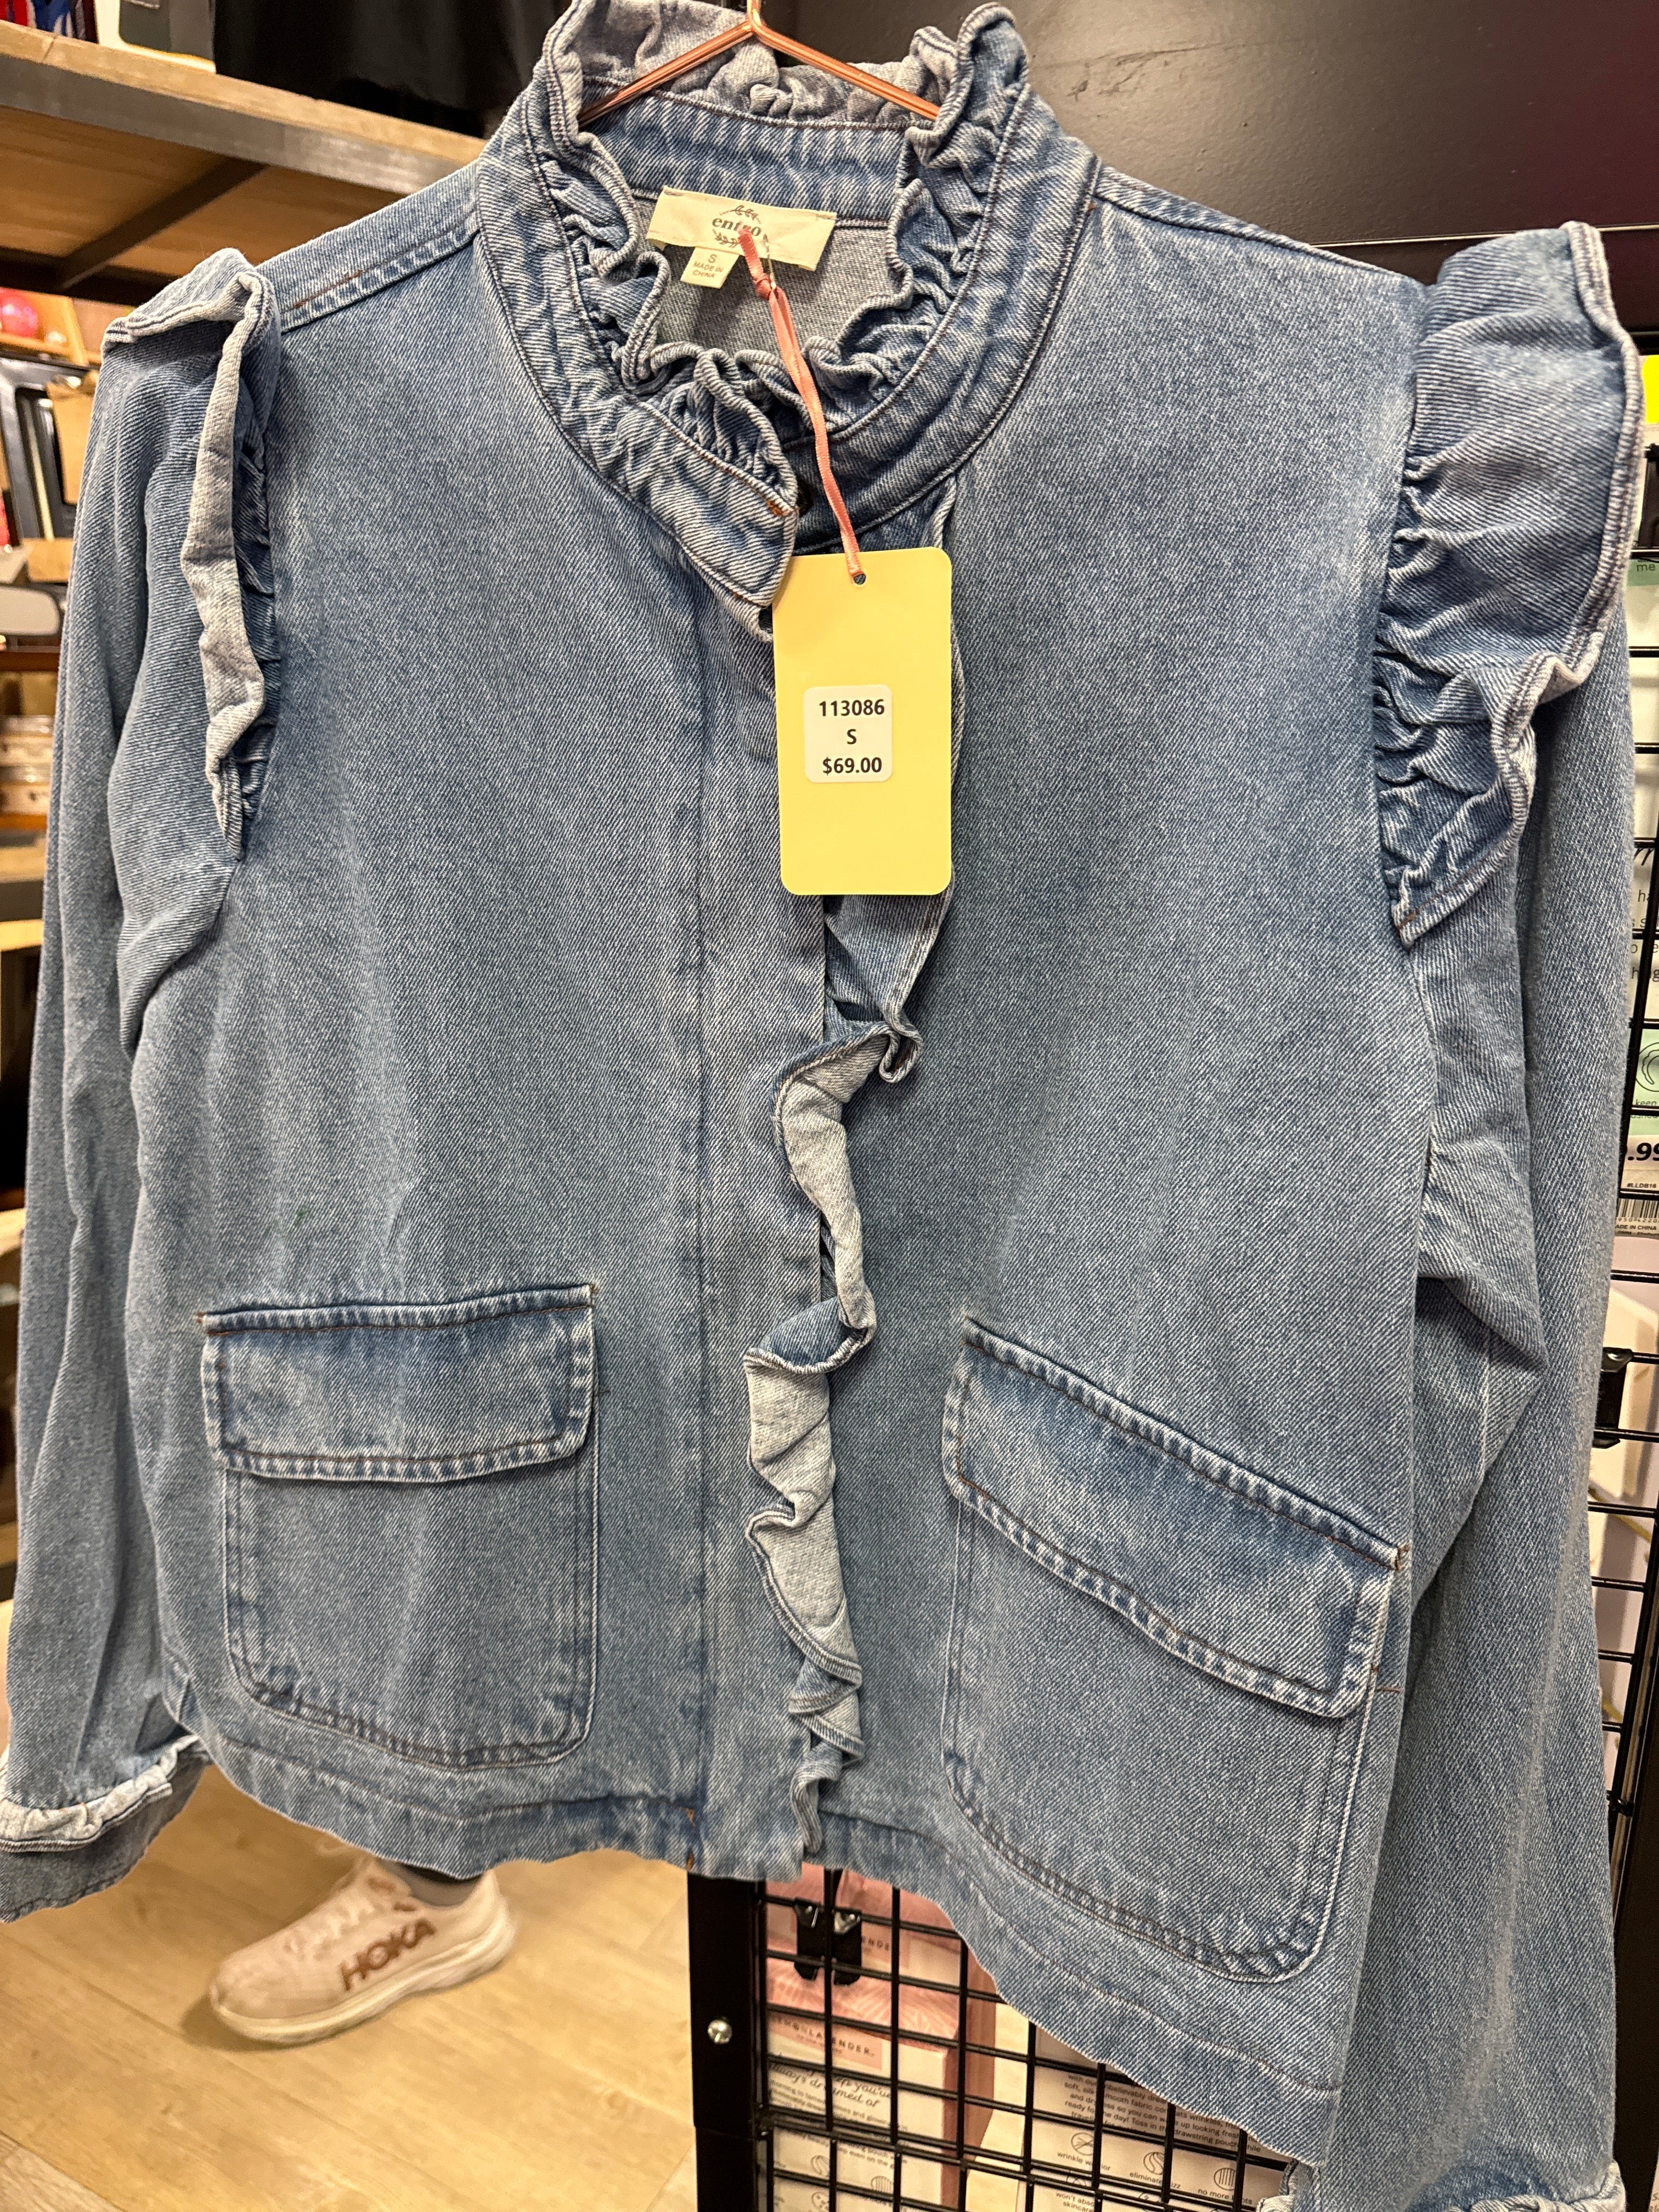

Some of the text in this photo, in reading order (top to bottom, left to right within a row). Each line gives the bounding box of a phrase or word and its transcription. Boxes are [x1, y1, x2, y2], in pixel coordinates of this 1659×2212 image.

[708, 255, 717, 263] S
[693, 261, 714, 271] MADE
[693, 269, 715, 278] CHINA
[820, 699, 884, 716] 113086
[847, 729, 857, 745] S
[822, 757, 882, 776] $69.00
[1627, 1143, 1659, 1161] .9
[1105, 2093, 1129, 2104] mooth
[1065, 2101, 1085, 2112] ready
[1193, 2124, 1220, 2137] looking
[1057, 2151, 1083, 2164] wrinkle
[1056, 2193, 1094, 2207] won't abso
[1210, 2191, 1229, 2200] more
